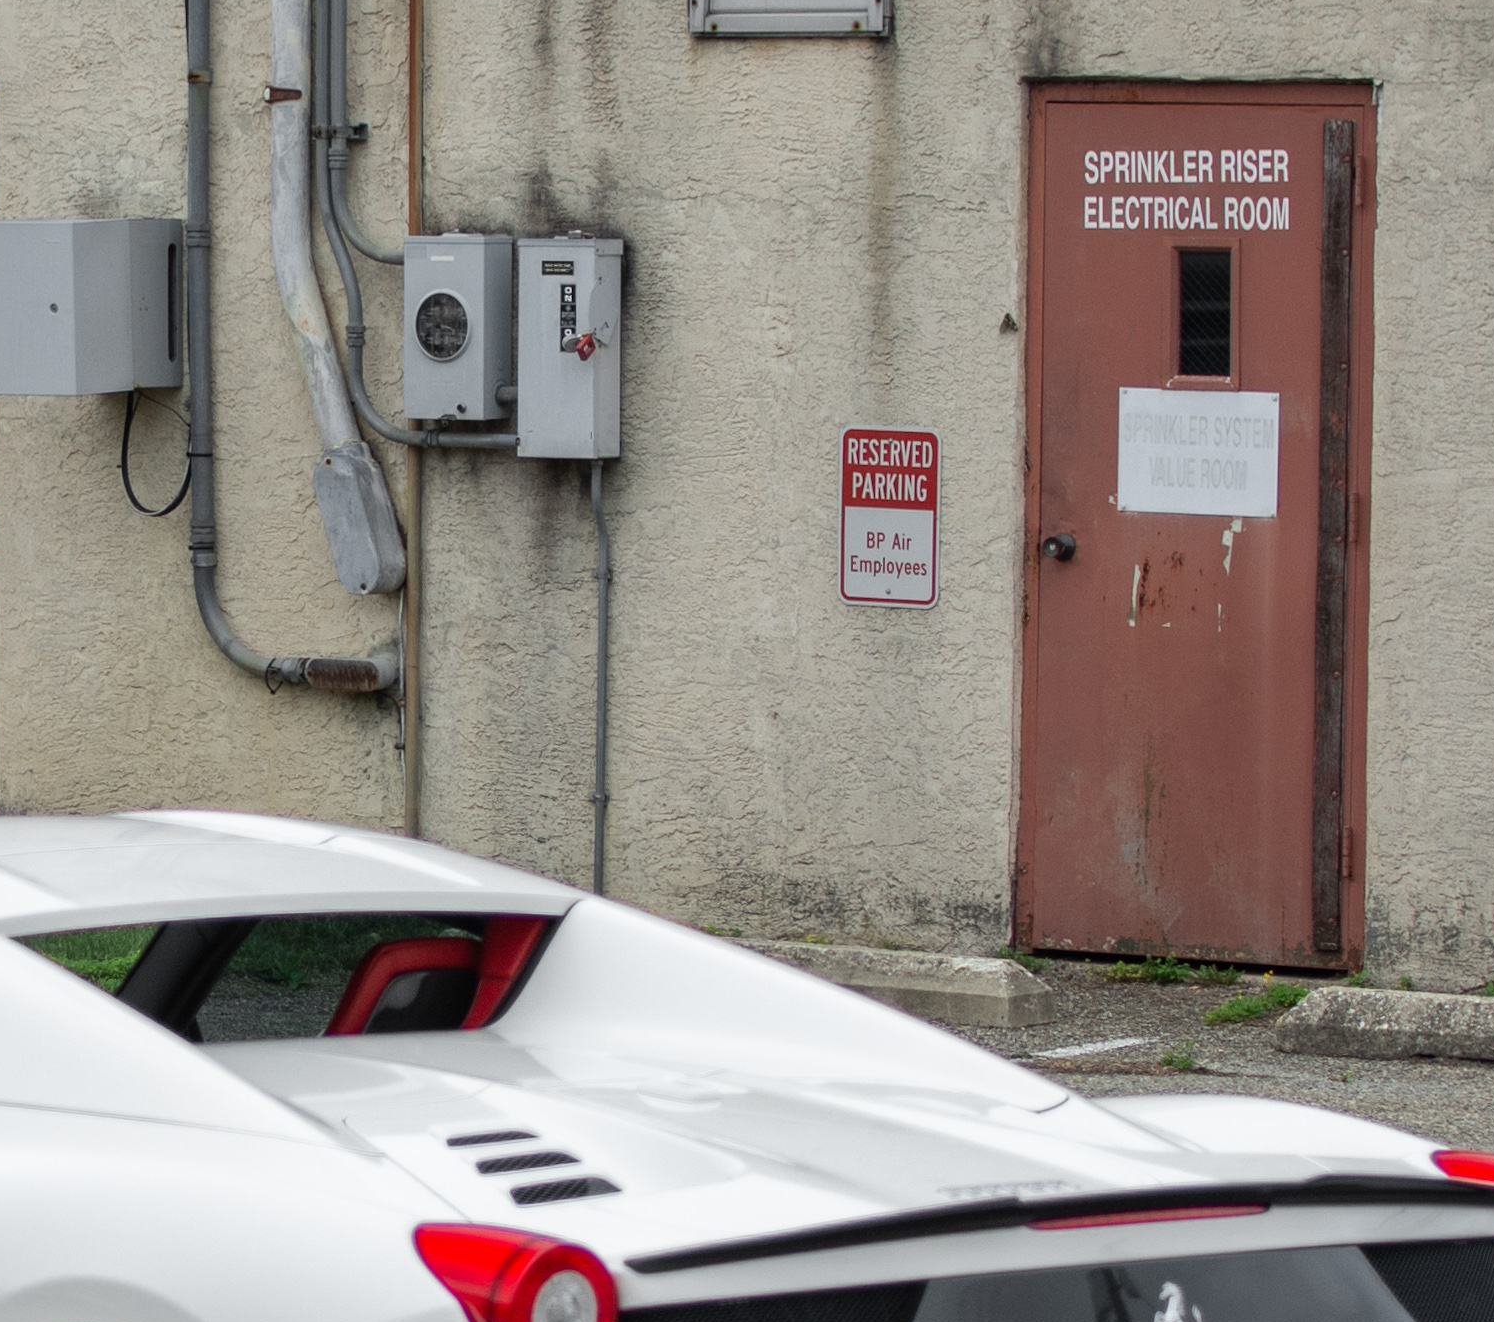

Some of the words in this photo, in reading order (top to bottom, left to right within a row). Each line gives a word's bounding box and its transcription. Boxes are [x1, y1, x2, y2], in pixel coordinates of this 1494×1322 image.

[1084, 149, 1213, 185] SPRINKLER
[1220, 148, 1289, 184] RISER
[1084, 196, 1218, 230] ELECTRICAL
[1224, 196, 1289, 231] ROOM
[1123, 412, 1208, 446] SPRINKLER
[1213, 416, 1274, 449] SYSTEM
[847, 437, 933, 469] RESERVED
[852, 472, 928, 502] PARKING
[1149, 457, 1196, 488] VALUE
[1200, 458, 1247, 491] ROOM
[866, 531, 886, 549] BP
[892, 533, 912, 551] Air
[850, 555, 927, 579] Employees
